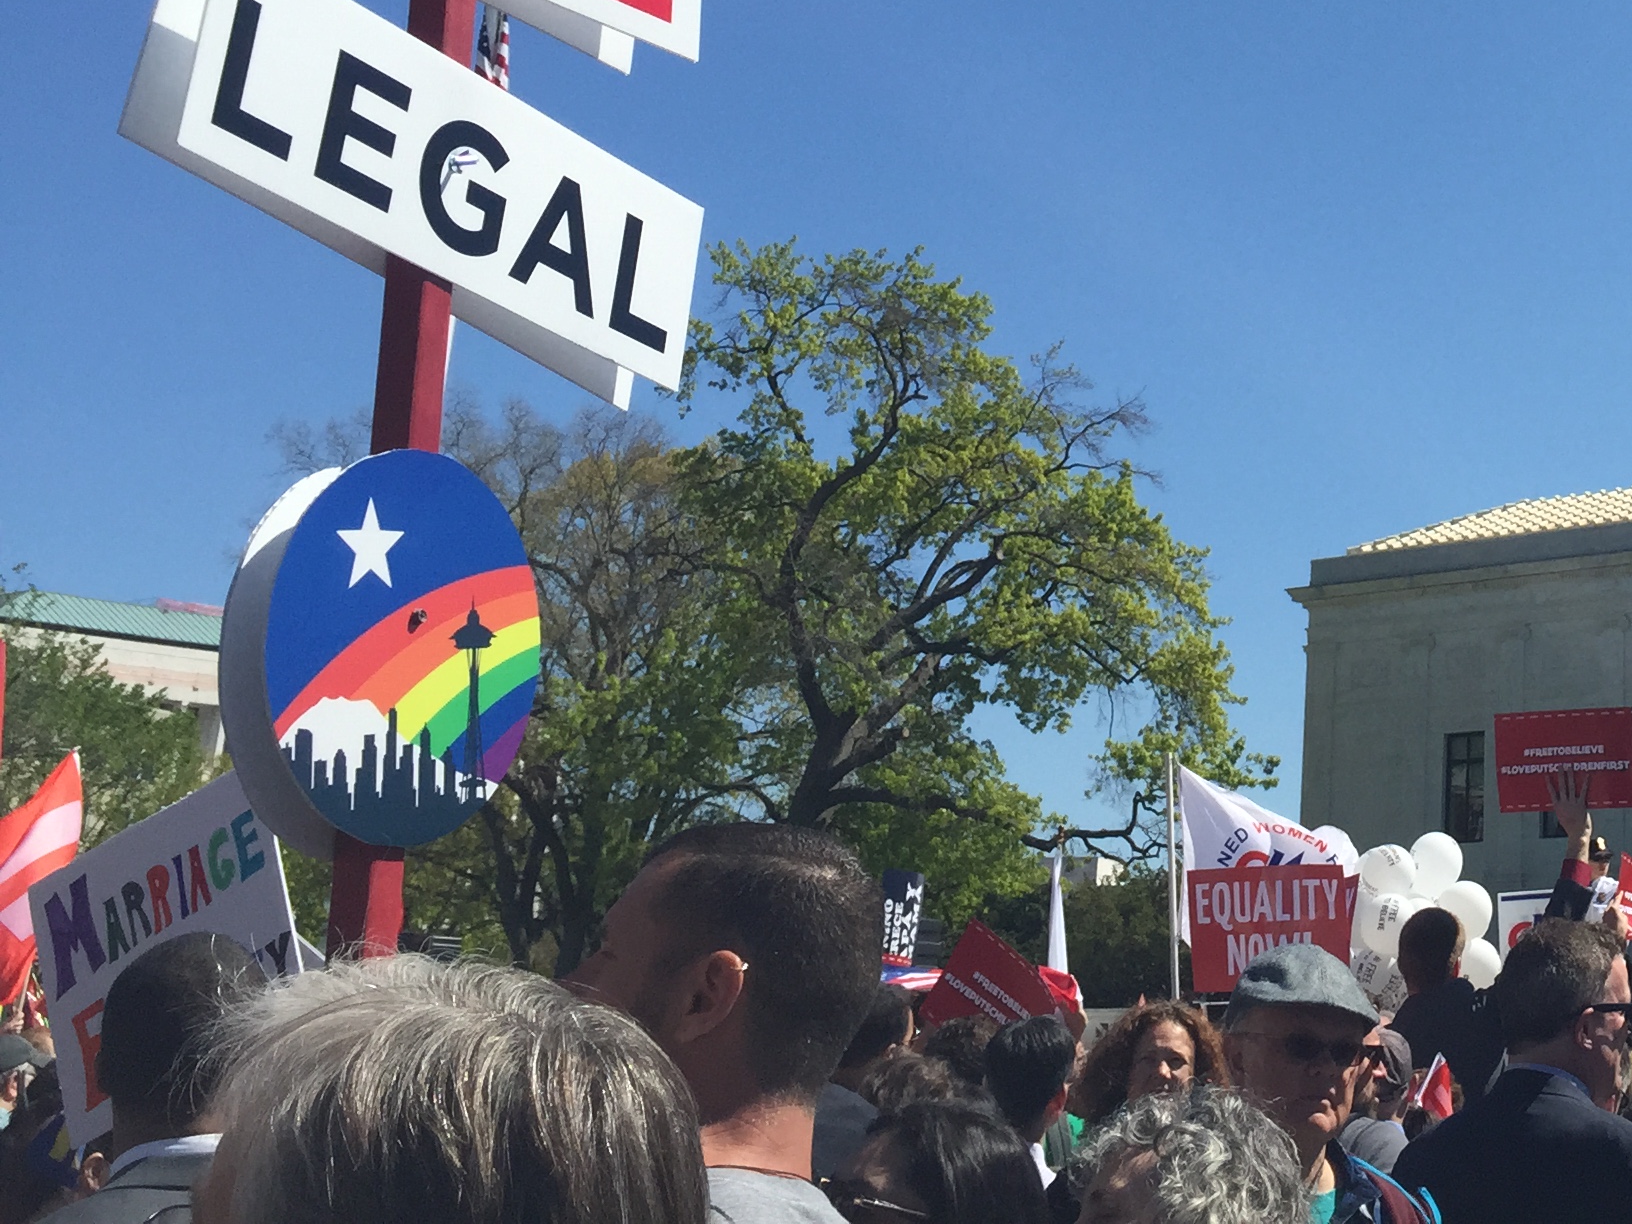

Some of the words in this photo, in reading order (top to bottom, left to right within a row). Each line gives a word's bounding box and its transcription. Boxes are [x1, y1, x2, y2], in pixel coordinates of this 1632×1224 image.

[1524, 744, 1605, 758] #FREETOBELIEVE
[1501, 760, 1630, 775] #LOVEPUTSCDRENFIRST
[1253, 822, 1328, 853] WOMEN
[44, 809, 266, 1001] MARRIAGE
[1195, 878, 1339, 931] EQUALITY
